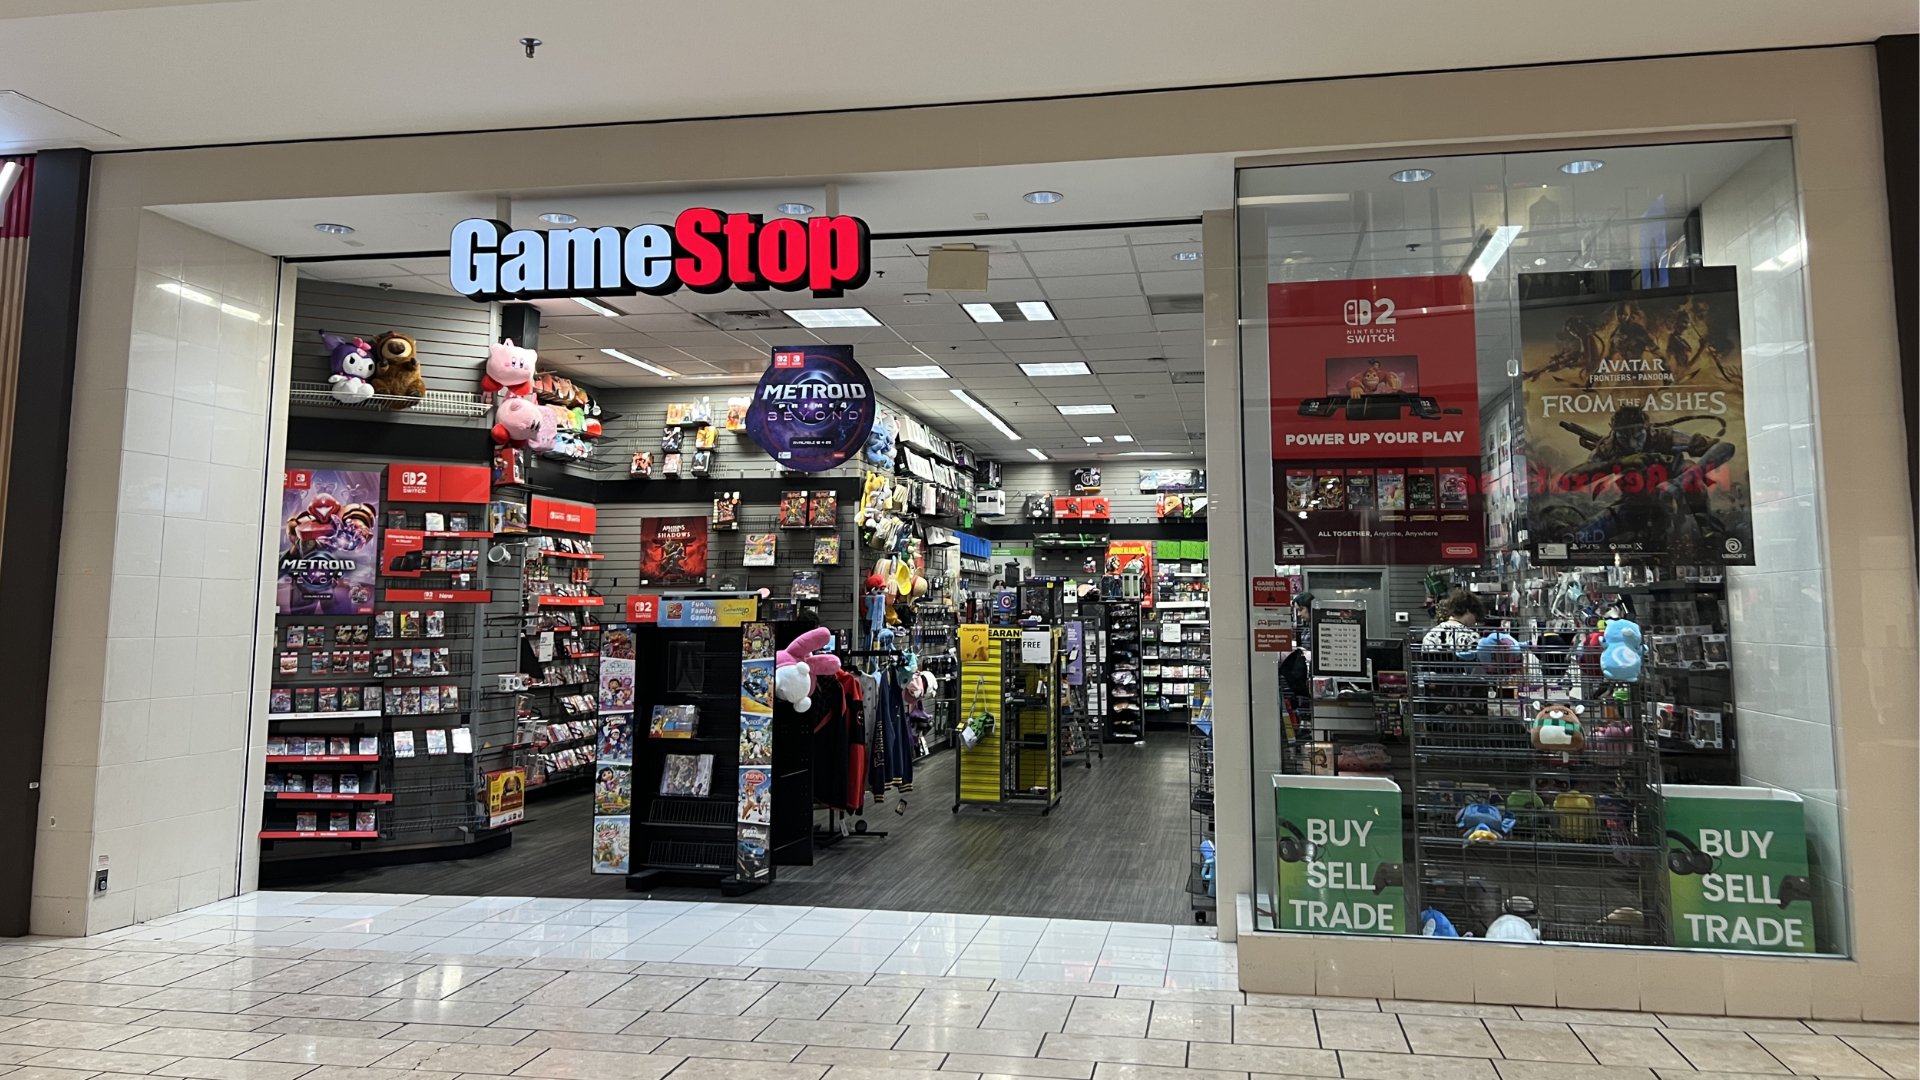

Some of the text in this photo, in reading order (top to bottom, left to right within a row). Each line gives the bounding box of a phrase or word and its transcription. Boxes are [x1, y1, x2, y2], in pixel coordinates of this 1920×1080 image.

[450, 207, 868, 299] GameStop
[1346, 334, 1396, 344] SWITCH
[1598, 358, 1665, 374] AVATAR
[1589, 374, 1631, 383] FRONTIERS
[1638, 373, 1675, 382] PANDORA
[761, 383, 867, 400] METROID
[1540, 391, 1728, 418] FROM THE ASHES
[767, 411, 859, 421] BEYOND
[1285, 430, 1465, 446] POWER UP YOUR PLAY
[1333, 530, 1373, 538] TOGETHER,
[1405, 530, 1439, 538] Anywhere
[281, 558, 356, 571] METROID
[690, 607, 716, 615] Family.
[690, 614, 719, 622] Gaming.
[988, 629, 1022, 637] EARAN
[1022, 641, 1041, 649] FREE
[1307, 818, 1373, 848] BUY
[1700, 828, 1774, 859] BUY
[1307, 860, 1376, 891] SELL
[1702, 872, 1781, 905] SELL
[1288, 899, 1394, 931] TRADE
[1683, 913, 1805, 948] TRADE
